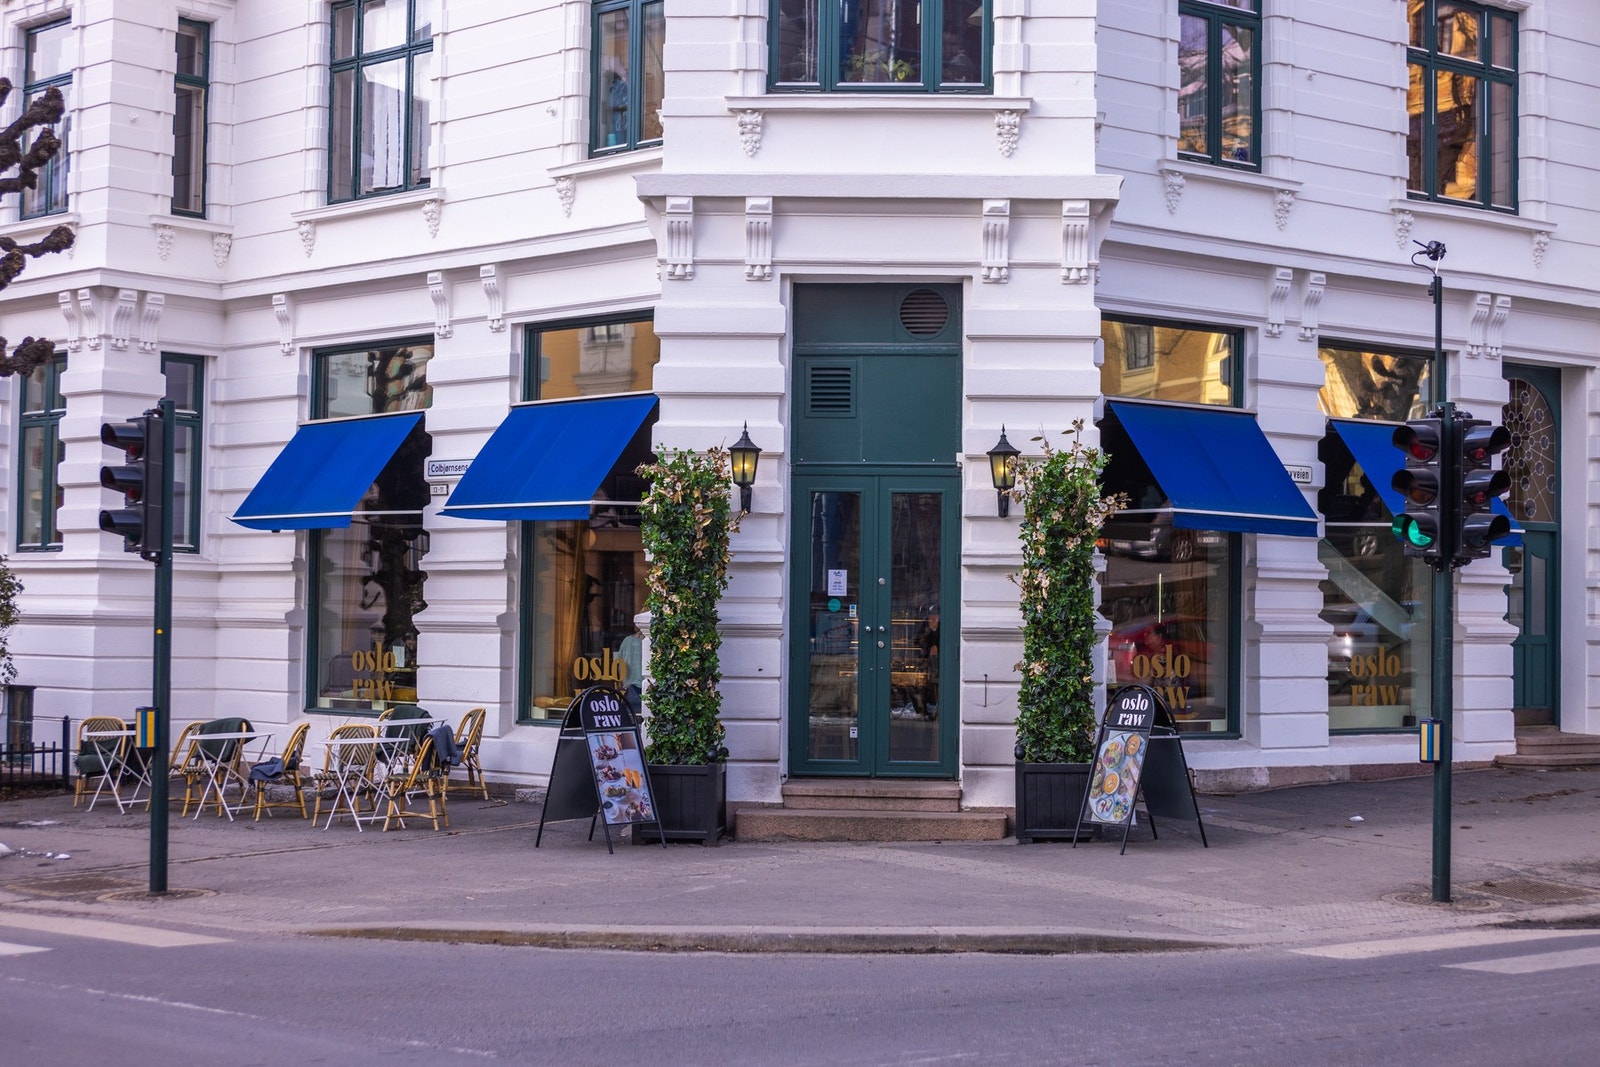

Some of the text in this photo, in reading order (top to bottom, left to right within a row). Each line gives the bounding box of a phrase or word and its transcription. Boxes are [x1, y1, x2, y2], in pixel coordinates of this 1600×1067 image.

[352, 641, 396, 673] oslo
[573, 647, 627, 682] oslo
[1133, 644, 1191, 679] oslo
[1350, 645, 1401, 678] oslo
[352, 678, 396, 701] raw
[1351, 684, 1400, 707] raw
[590, 695, 620, 713] oslo
[1121, 693, 1149, 711] oslo
[593, 713, 622, 728] raw
[1117, 712, 1146, 726] raw
